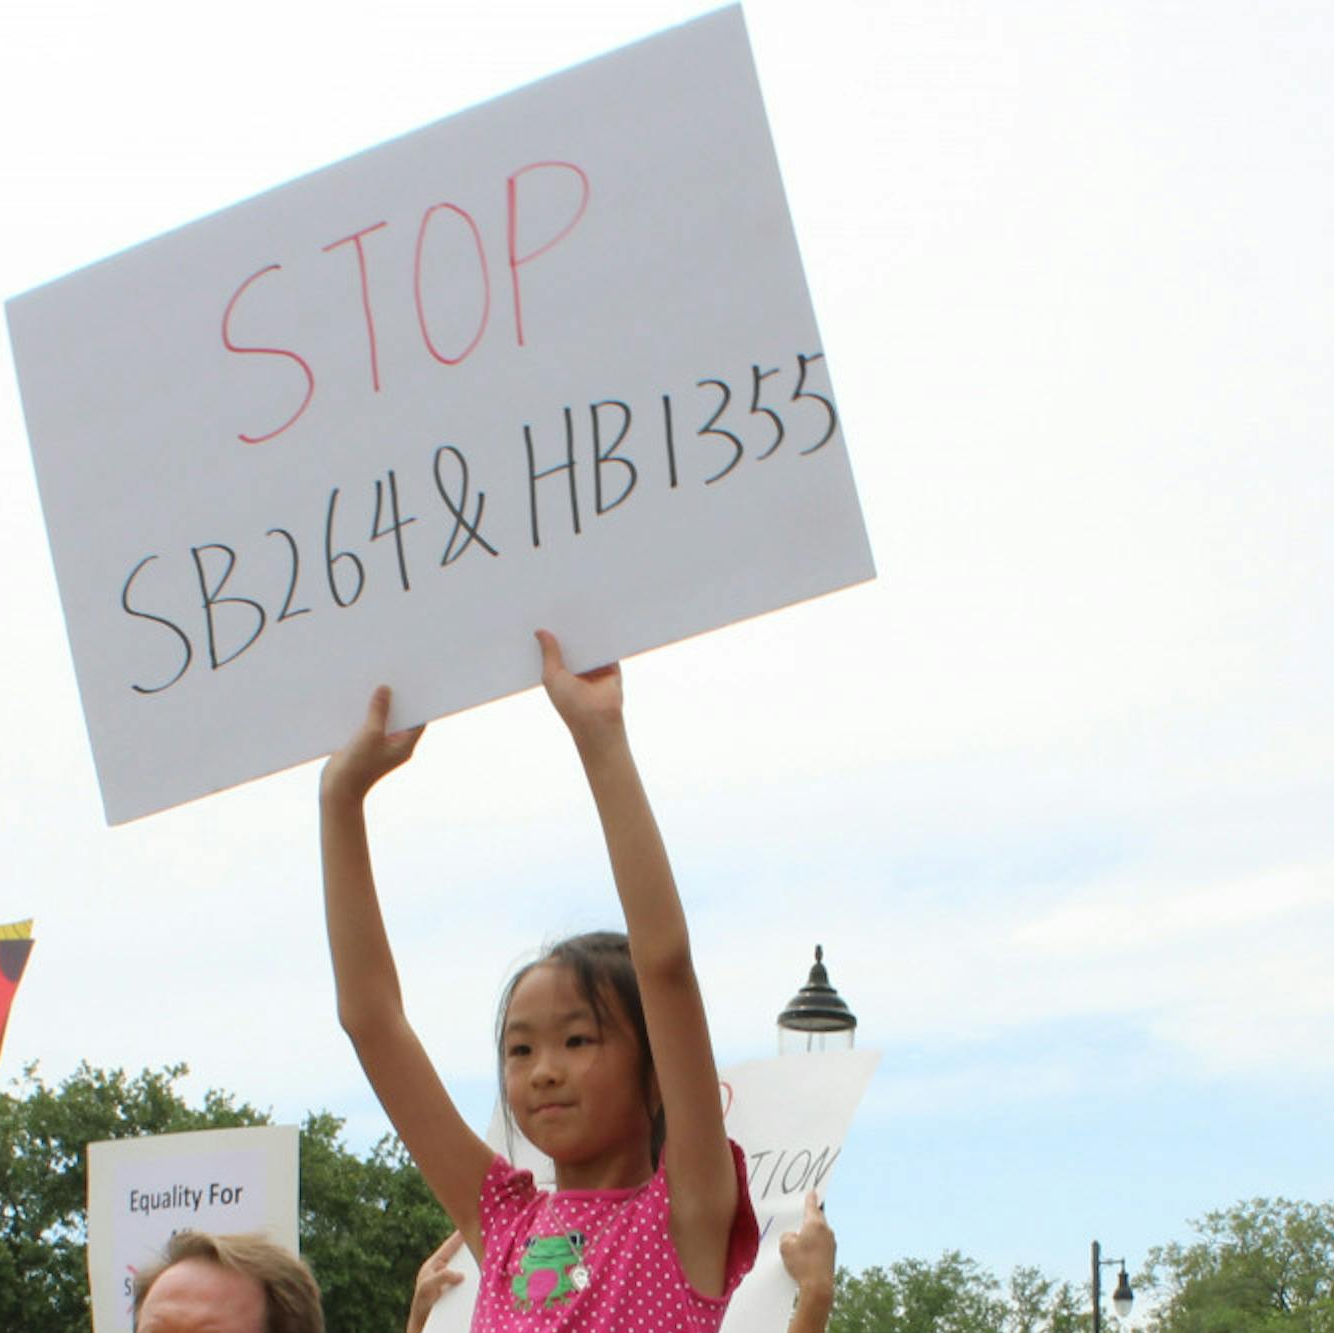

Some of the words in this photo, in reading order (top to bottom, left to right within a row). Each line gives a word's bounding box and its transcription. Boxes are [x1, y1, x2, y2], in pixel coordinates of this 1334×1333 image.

[221, 160, 590, 446] STOP
[120, 469, 416, 696] SB264
[433, 445, 501, 568] &
[523, 352, 838, 550] HB1355
[130, 1184, 203, 1216] Equality
[209, 1183, 244, 1207] For
